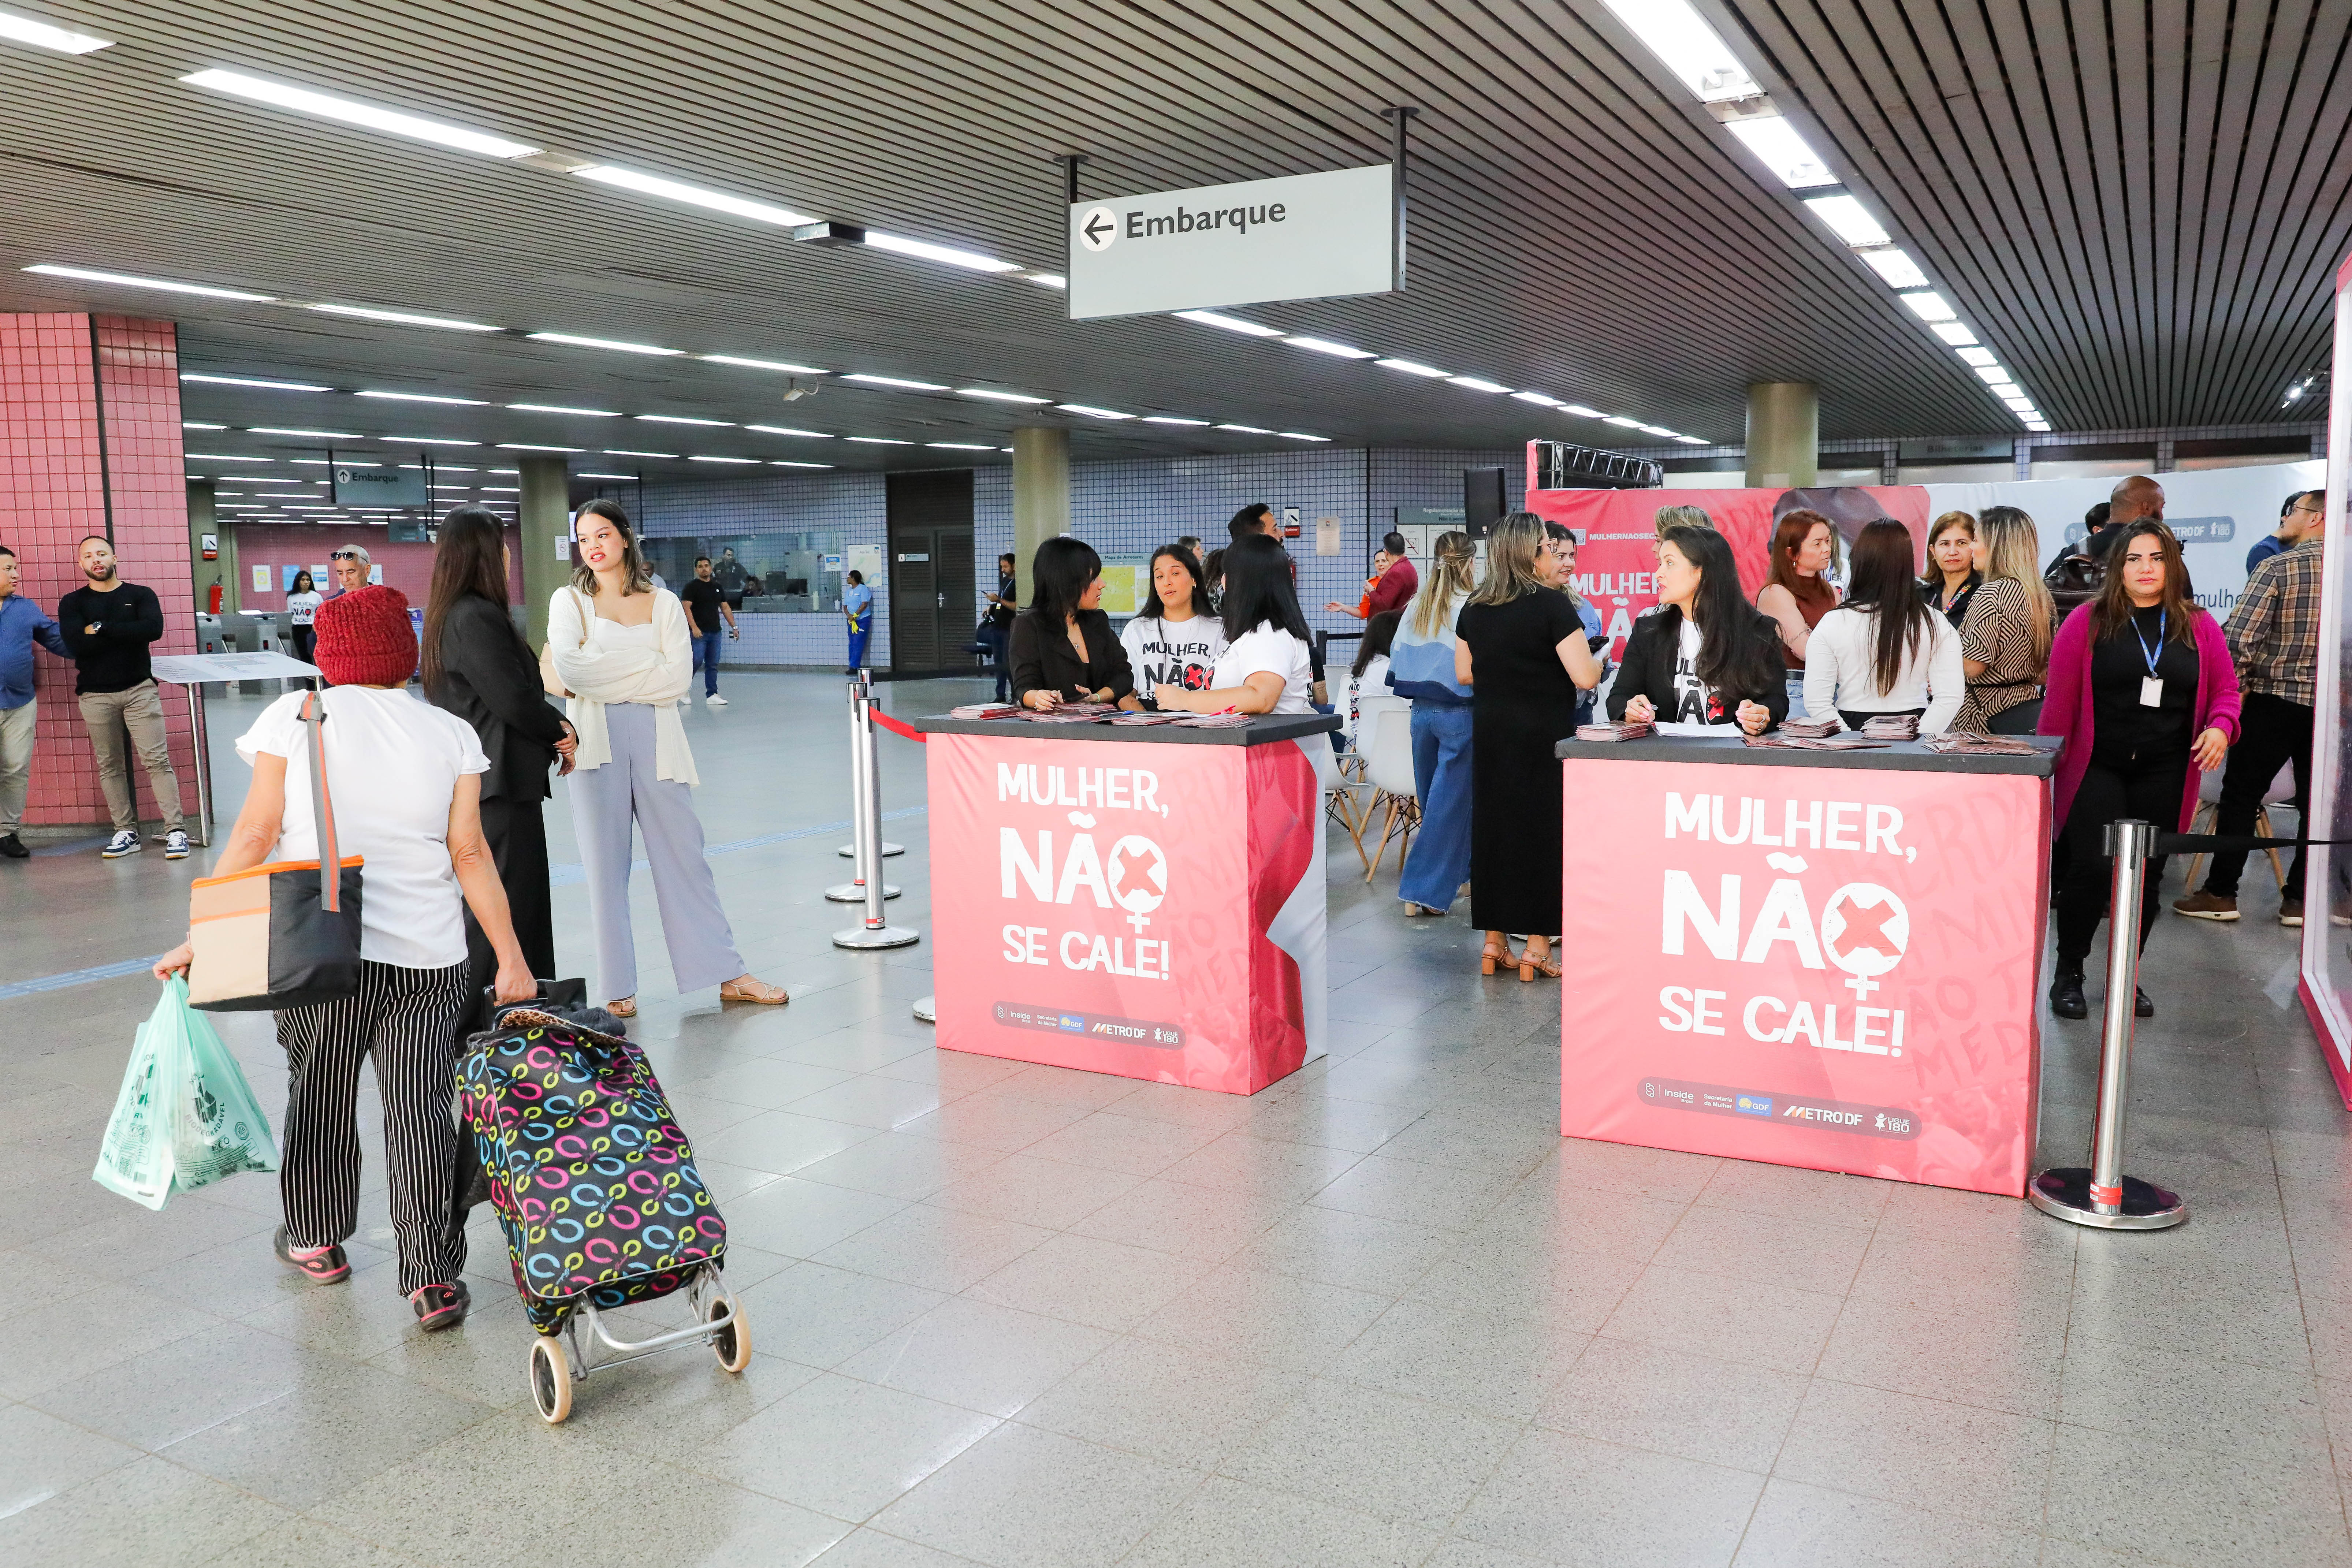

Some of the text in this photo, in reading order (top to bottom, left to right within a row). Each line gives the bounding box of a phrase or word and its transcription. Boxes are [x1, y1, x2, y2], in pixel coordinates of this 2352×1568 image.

[1127, 203, 1285, 239] Embarque
[353, 473, 399, 484] Embarque
[1142, 641, 1210, 659] MULHER,
[997, 762, 1169, 819] MULHER,
[1665, 792, 1917, 864] MULHER,
[1000, 811, 1168, 934] NÃO
[1661, 852, 1910, 1001] NÃO
[1002, 924, 1169, 980] SE CALE!
[1010, 1011, 1031, 1020] Inside
[1659, 986, 1905, 1058] SE CALE!
[1163, 1035, 1179, 1044] 180
[1664, 1089, 1694, 1100] Inside
[1704, 1094, 1733, 1103] Secretaria
[1752, 1103, 1770, 1111] GDF
[1887, 1117, 1910, 1125] LIGUE
[1888, 1122, 1910, 1133] 180
